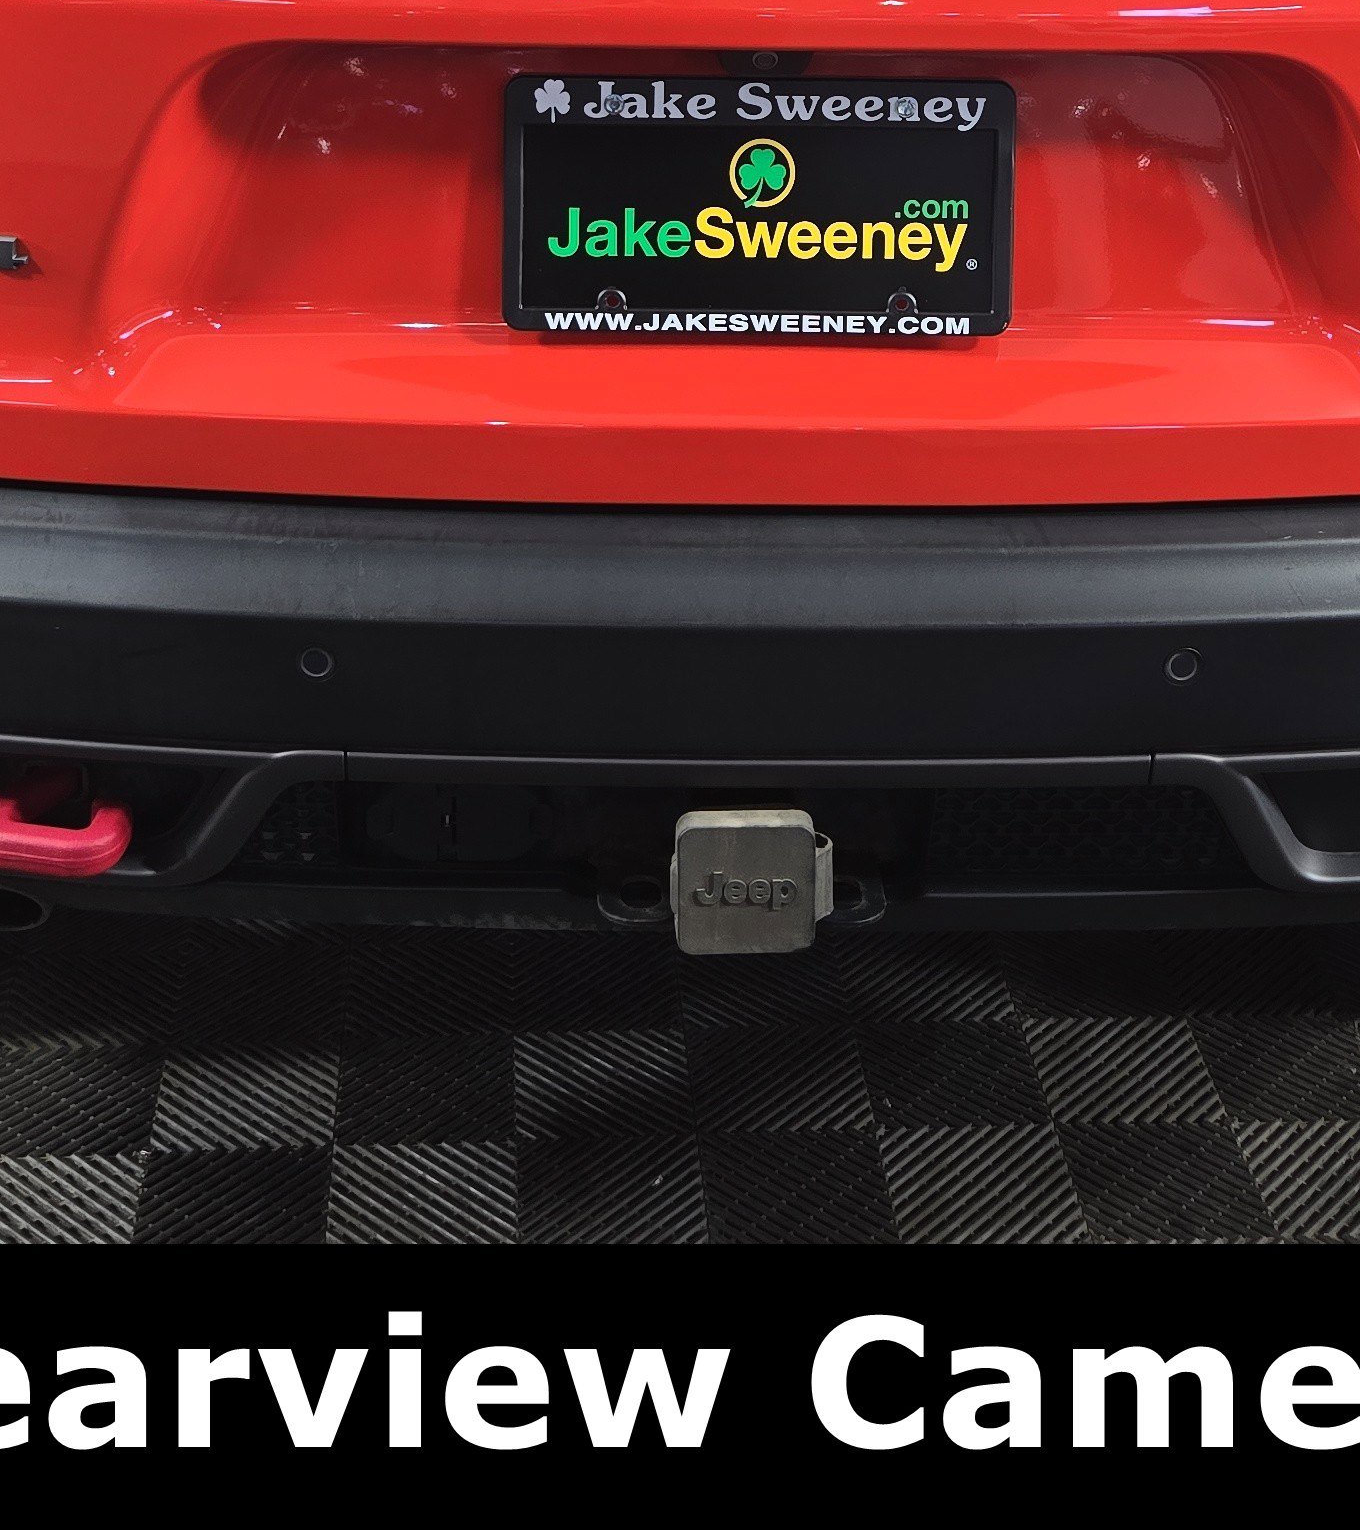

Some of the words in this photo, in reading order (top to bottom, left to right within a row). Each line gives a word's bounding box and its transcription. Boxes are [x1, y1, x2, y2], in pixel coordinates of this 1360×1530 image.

[584, 80, 717, 120] Jake
[737, 82, 987, 132] Sweeney
[893, 199, 969, 220] .com
[547, 207, 969, 273] JakeSweeney
[544, 312, 970, 335] WWW.JAKESWEENEY.COM
[695, 871, 798, 910] Jeep
